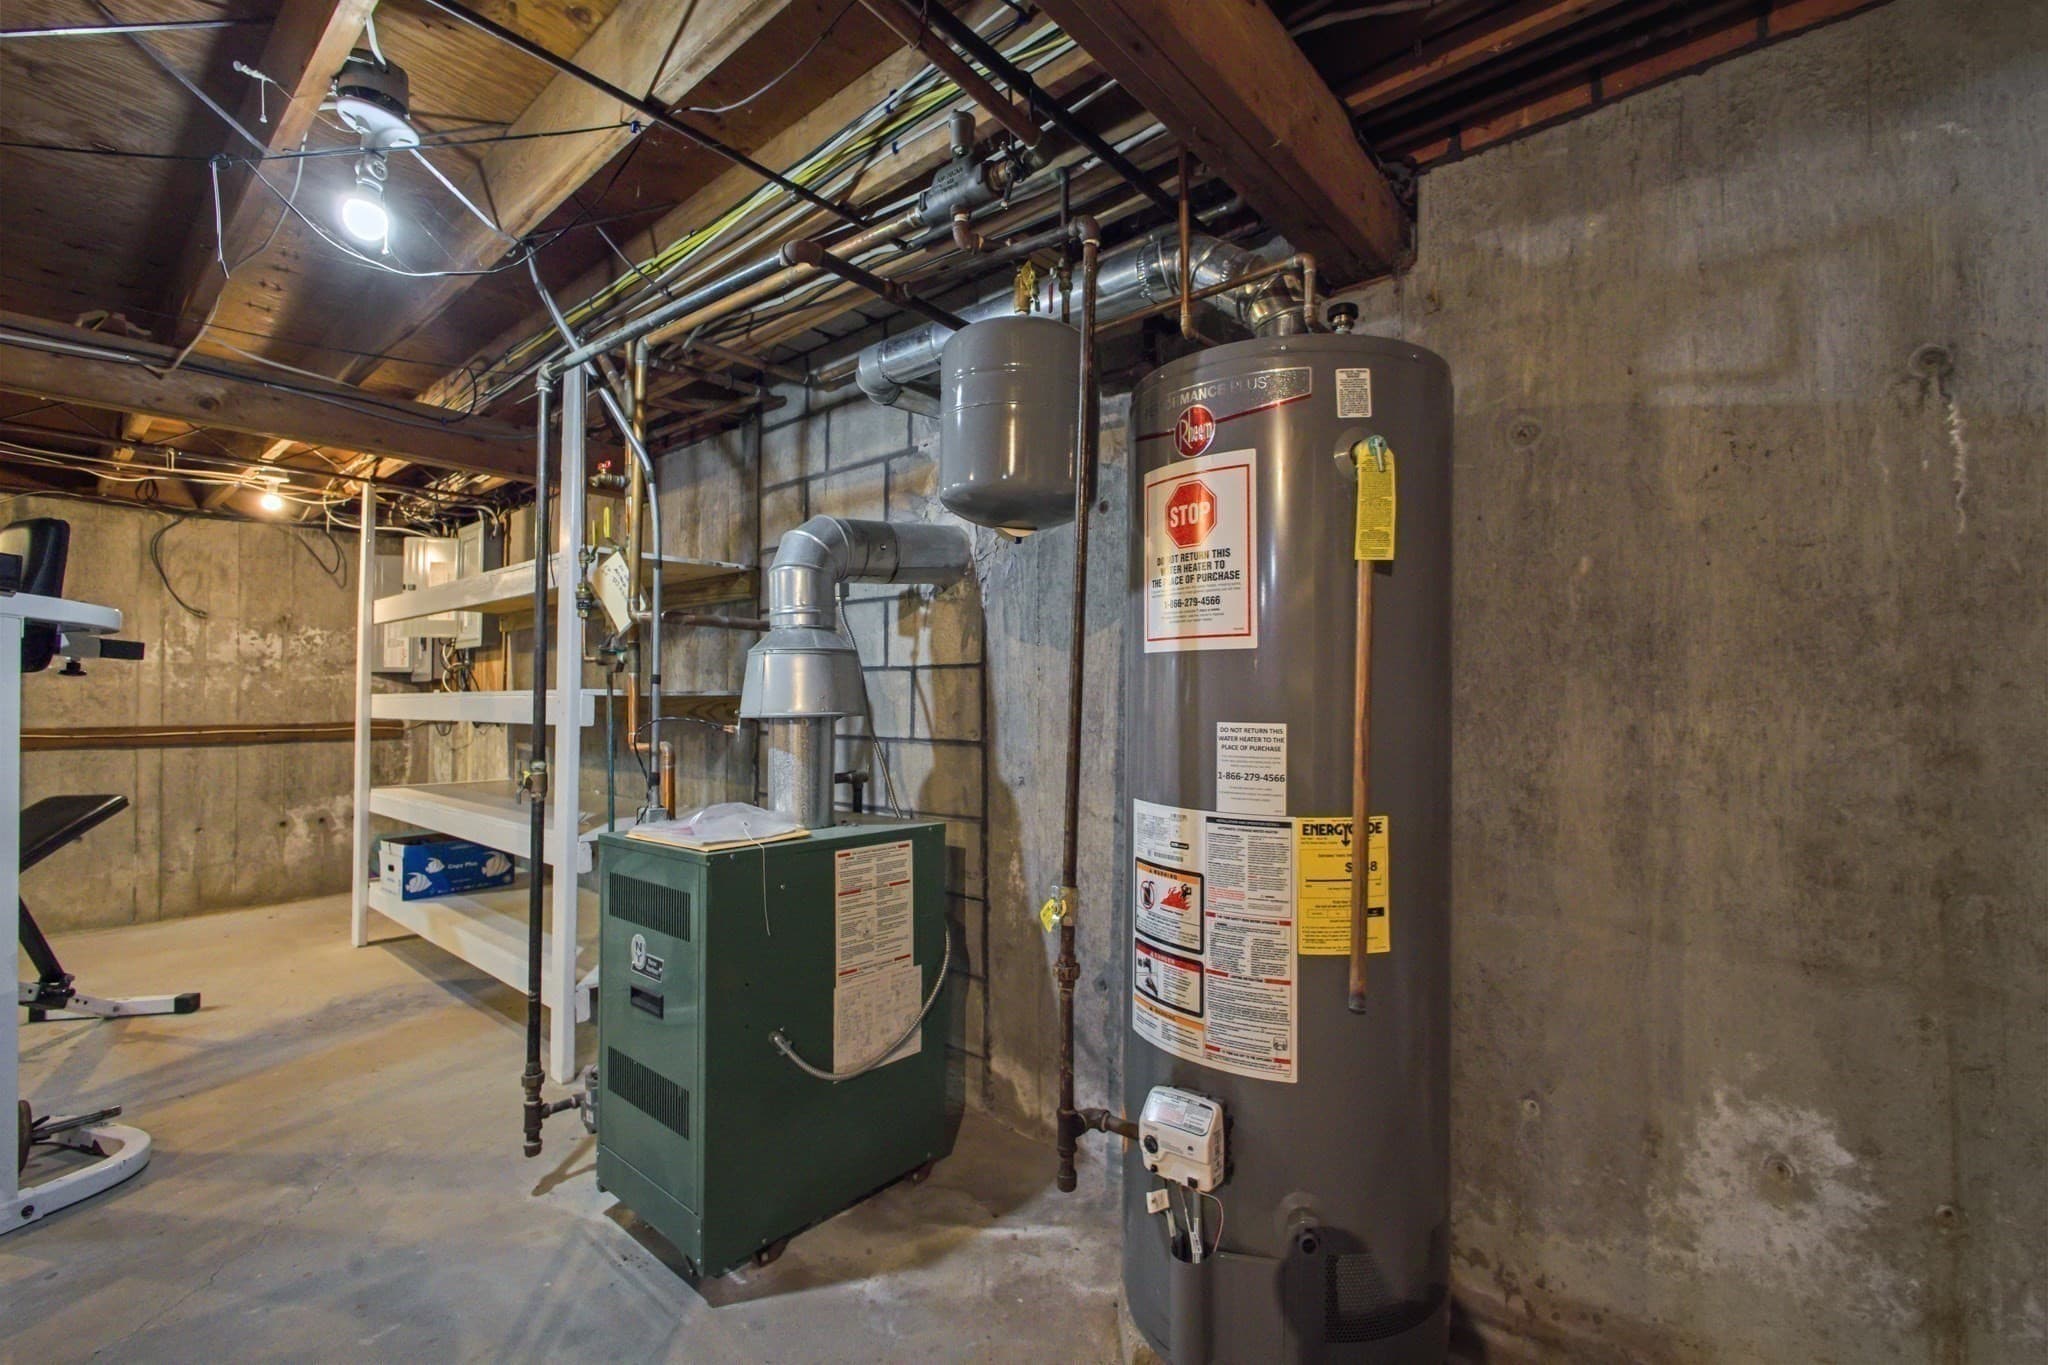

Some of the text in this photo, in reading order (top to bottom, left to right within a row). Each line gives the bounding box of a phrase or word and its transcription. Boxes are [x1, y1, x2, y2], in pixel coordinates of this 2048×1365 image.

[1179, 407, 1212, 450] Rheem
[1170, 501, 1211, 528] STOP
[1180, 550, 1209, 563] RETURN
[1212, 548, 1231, 560] THIS
[1183, 560, 1212, 574] HEATER
[1214, 559, 1225, 570] TO
[1152, 579, 1162, 589] THE
[1185, 574, 1195, 585] OF
[1196, 570, 1241, 583] PURCHASE
[1218, 771, 1286, 783] 1-866-279-4566
